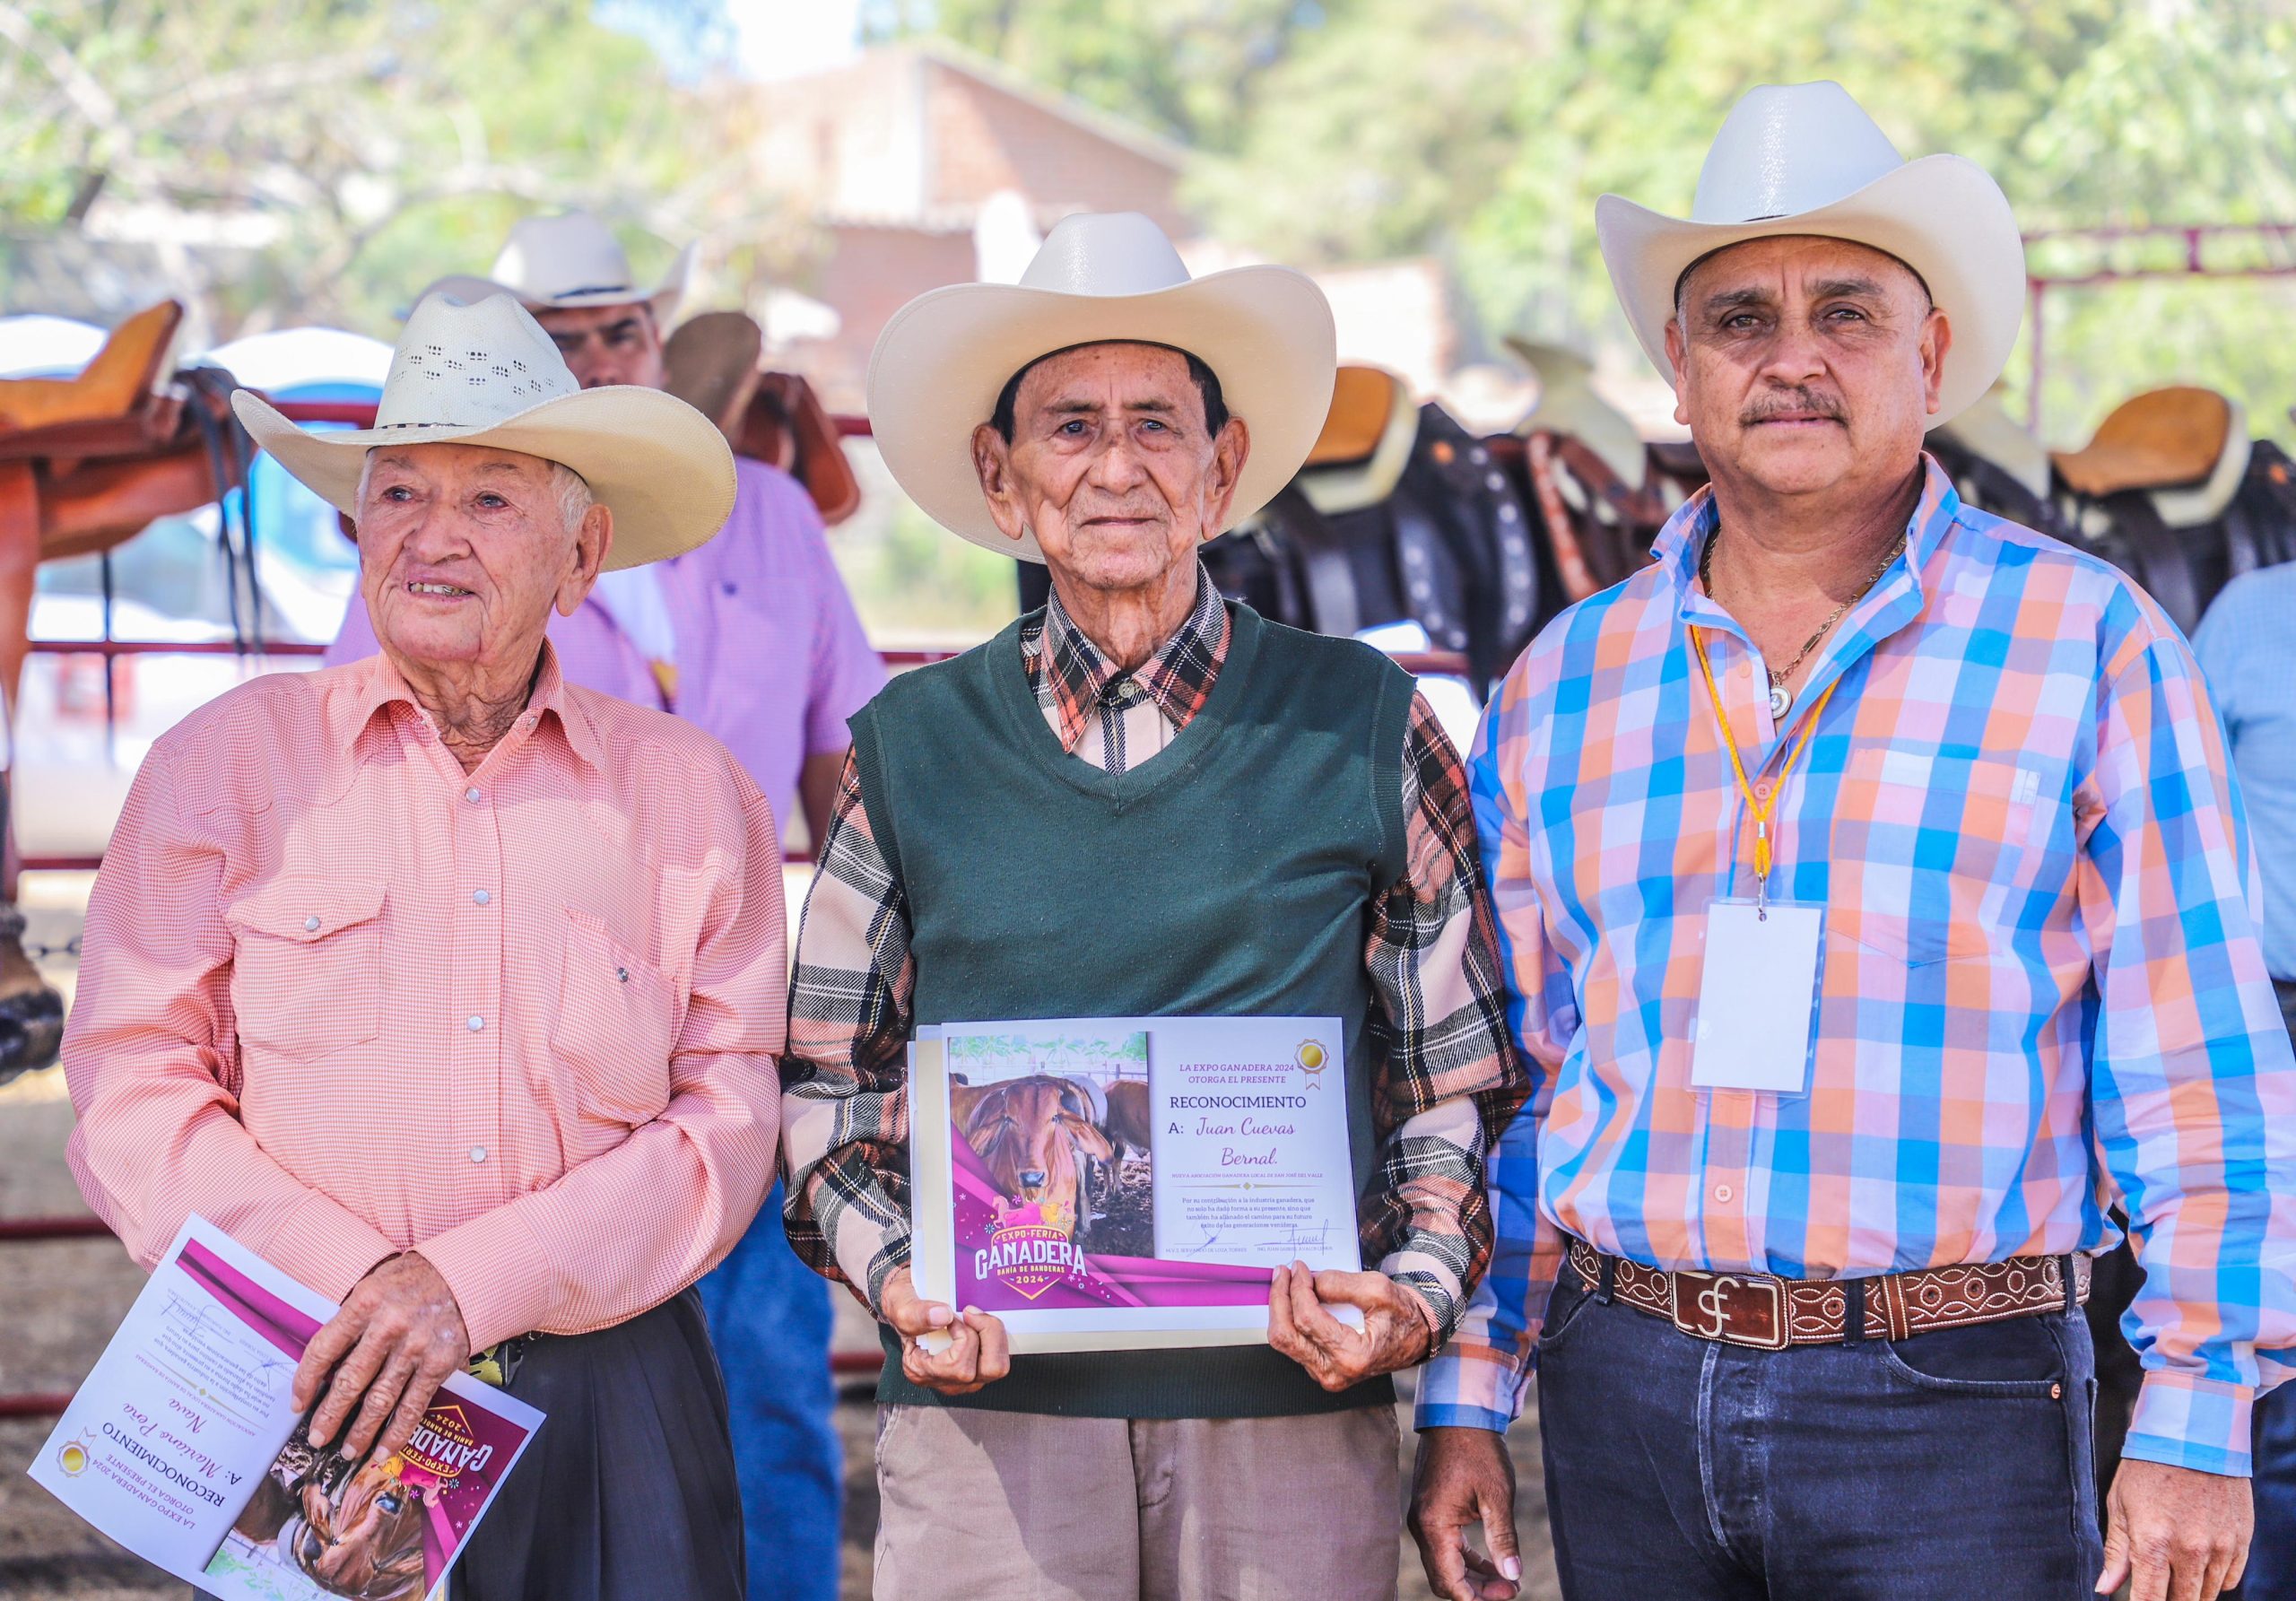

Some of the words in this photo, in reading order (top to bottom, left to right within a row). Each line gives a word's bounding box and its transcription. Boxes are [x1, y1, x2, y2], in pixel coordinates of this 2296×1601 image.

[1179, 1064, 1191, 1072] LA
[1193, 1064, 1219, 1072] EXPO
[1220, 1064, 1273, 1072] GANADERA
[1274, 1064, 1294, 1072] 2024
[1170, 1096, 1307, 1109] RECONOCIMIENTO
[1168, 1122, 1184, 1135] A:
[1196, 1117, 1236, 1135] Juan
[1240, 1117, 1296, 1135] Cuevas
[1221, 1147, 1278, 1166] Bernal.
[975, 1240, 1089, 1281] GANADERA
[996, 1265, 1017, 1276] BAHÍA
[1031, 1265, 1065, 1274] BANDERAS
[1015, 1275, 1044, 1284] 2024
[120, 1402, 158, 1437] Peña
[165, 1397, 207, 1433] Nava
[434, 1413, 462, 1431] 2024
[442, 1428, 452, 1438] DE
[453, 1434, 474, 1445] BAHÍA
[157, 1430, 222, 1479] Mariano
[406, 1423, 493, 1474] GANADE
[91, 1457, 111, 1475] 2024
[100, 1423, 226, 1507] RECONOCIMIENTO
[104, 1452, 147, 1486] PRESENTE
[224, 1470, 241, 1484] A:
[109, 1471, 159, 1509] GANADERA
[145, 1482, 158, 1493] EL
[156, 1488, 194, 1516] OTORGA
[156, 1502, 182, 1523] EXPO
[181, 1518, 196, 1530] LA
